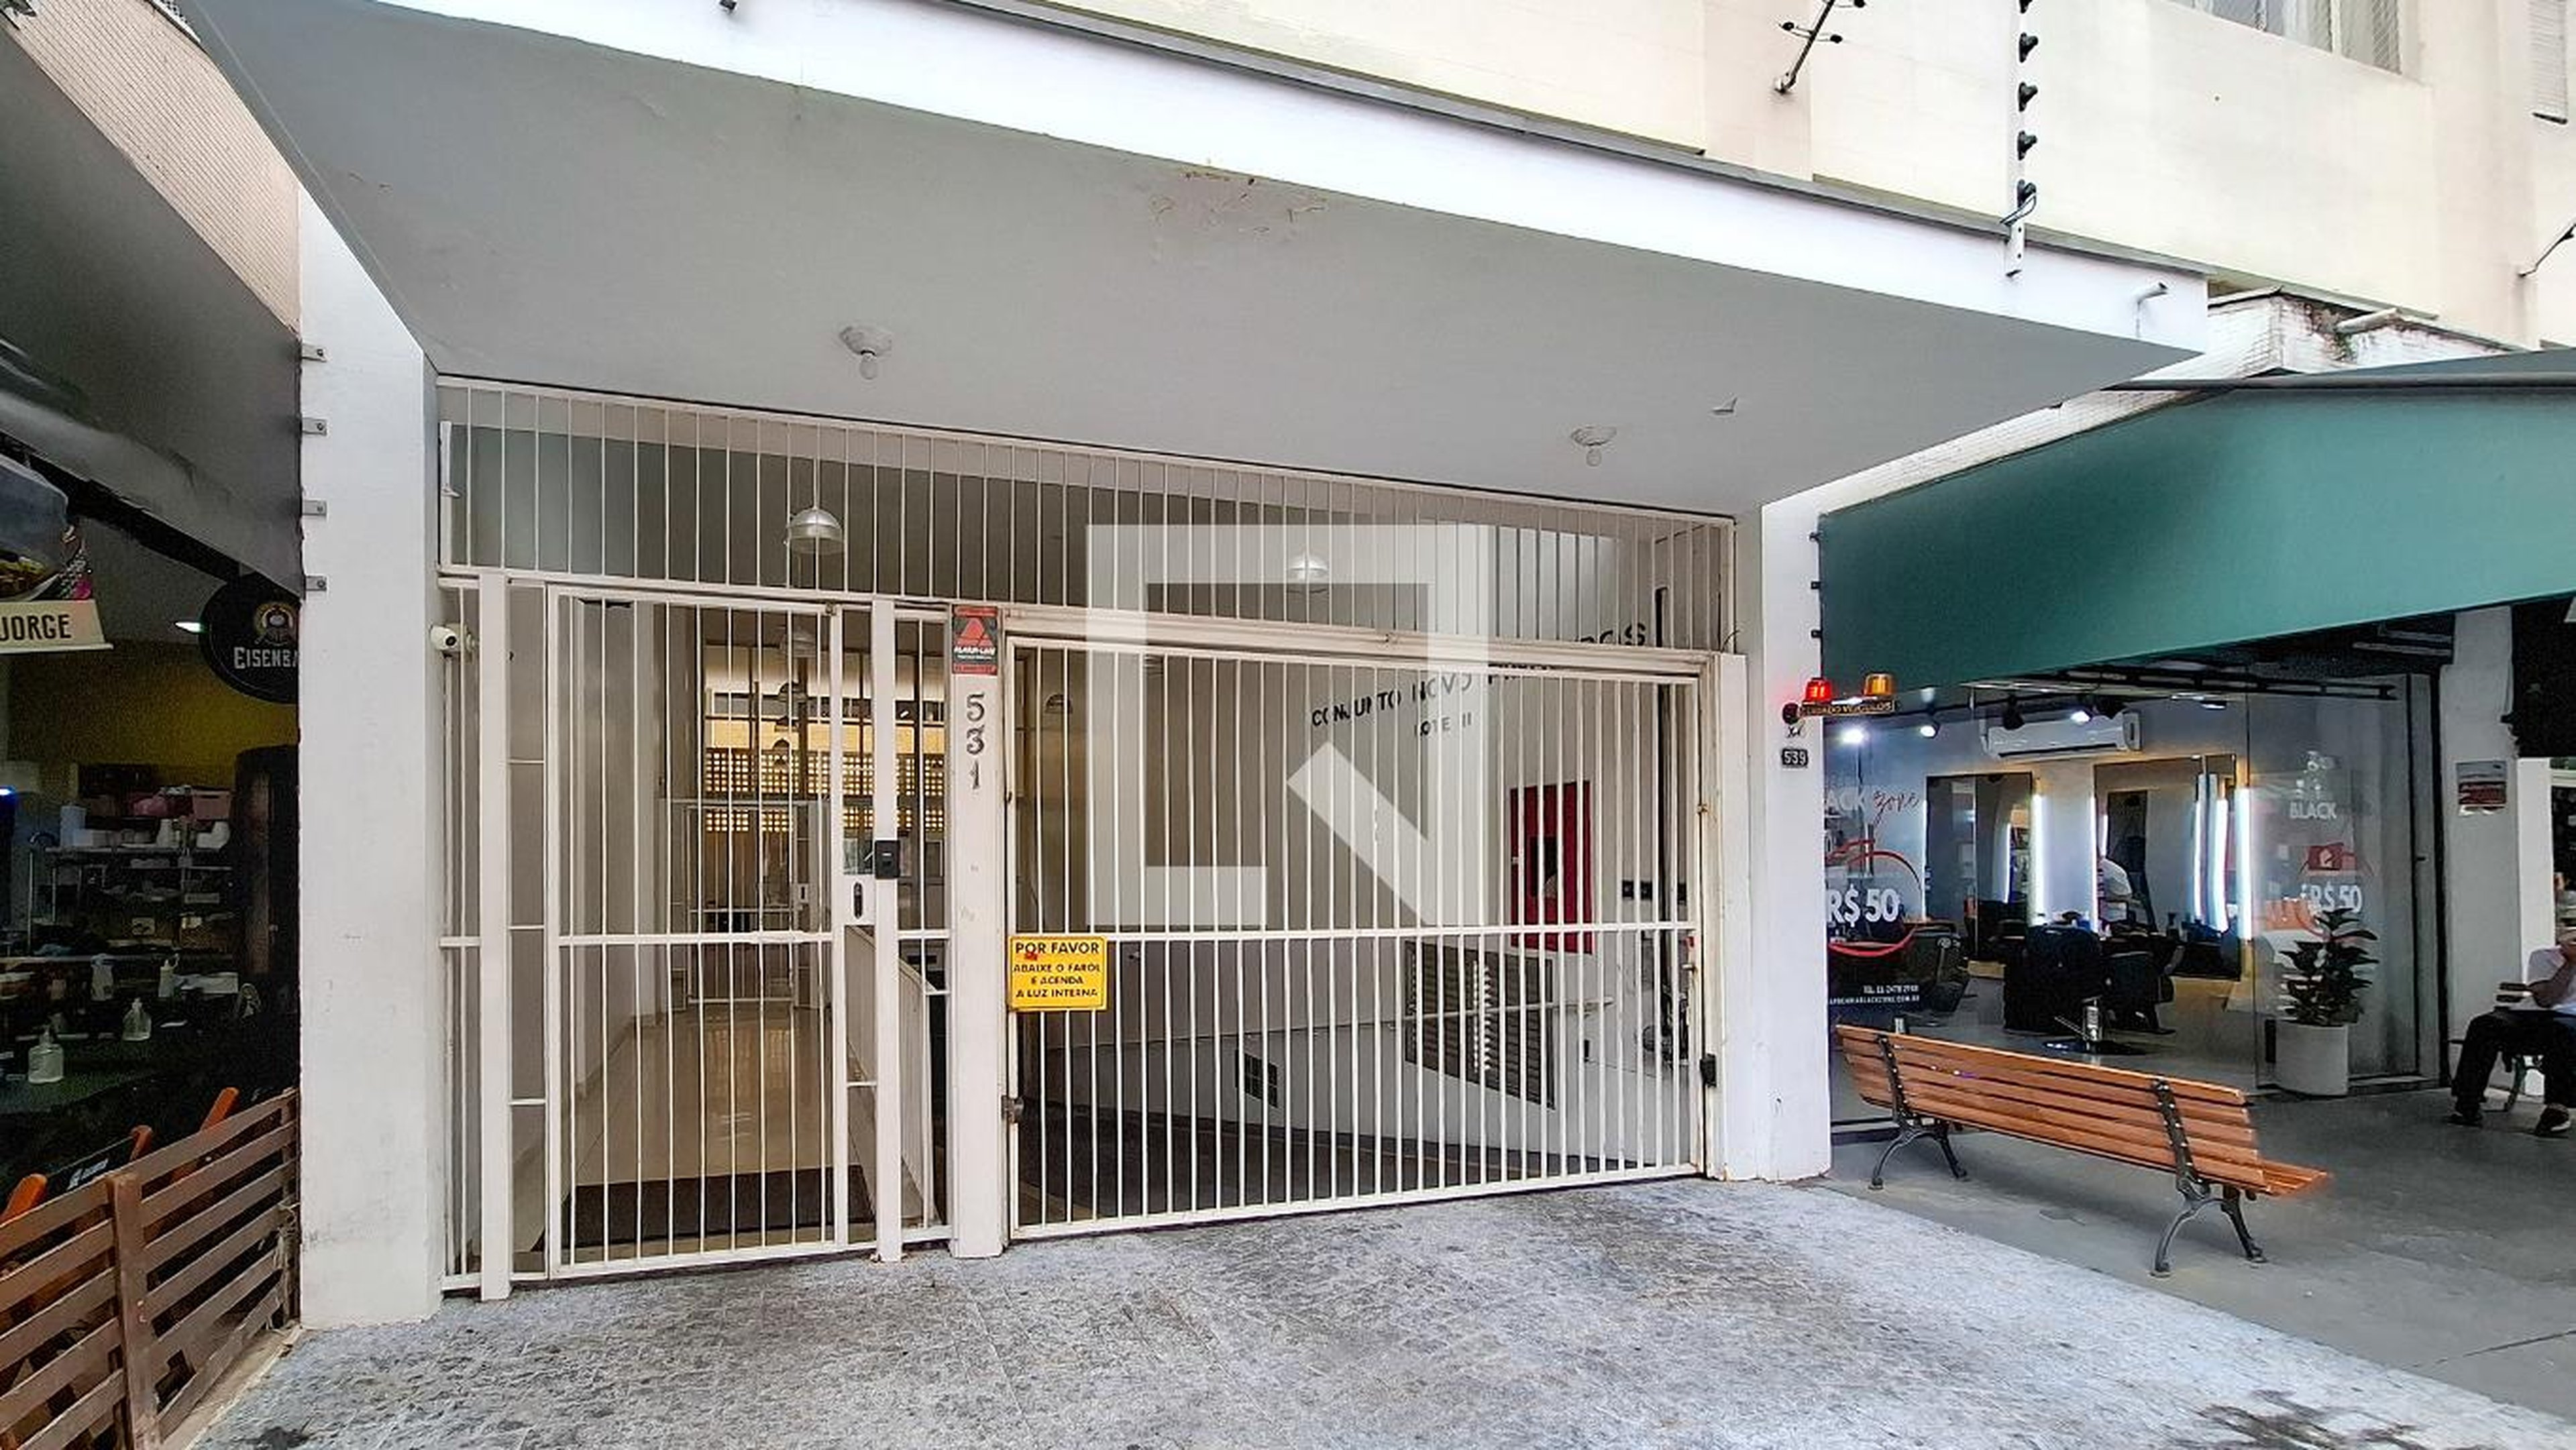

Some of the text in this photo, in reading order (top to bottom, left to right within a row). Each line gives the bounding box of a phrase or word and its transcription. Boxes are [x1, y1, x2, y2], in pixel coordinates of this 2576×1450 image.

[0, 614, 72, 641] JORGE
[966, 692, 985, 790] 531
[1784, 750, 1806, 765] 539
[2290, 801, 2337, 819] BLACK
[1826, 883, 1901, 928] R$ 50
[1016, 942, 1099, 954] POR FAVOR
[1014, 964, 1051, 972] ABAIXE
[1016, 989, 1098, 998] A LUZ INTERNA
